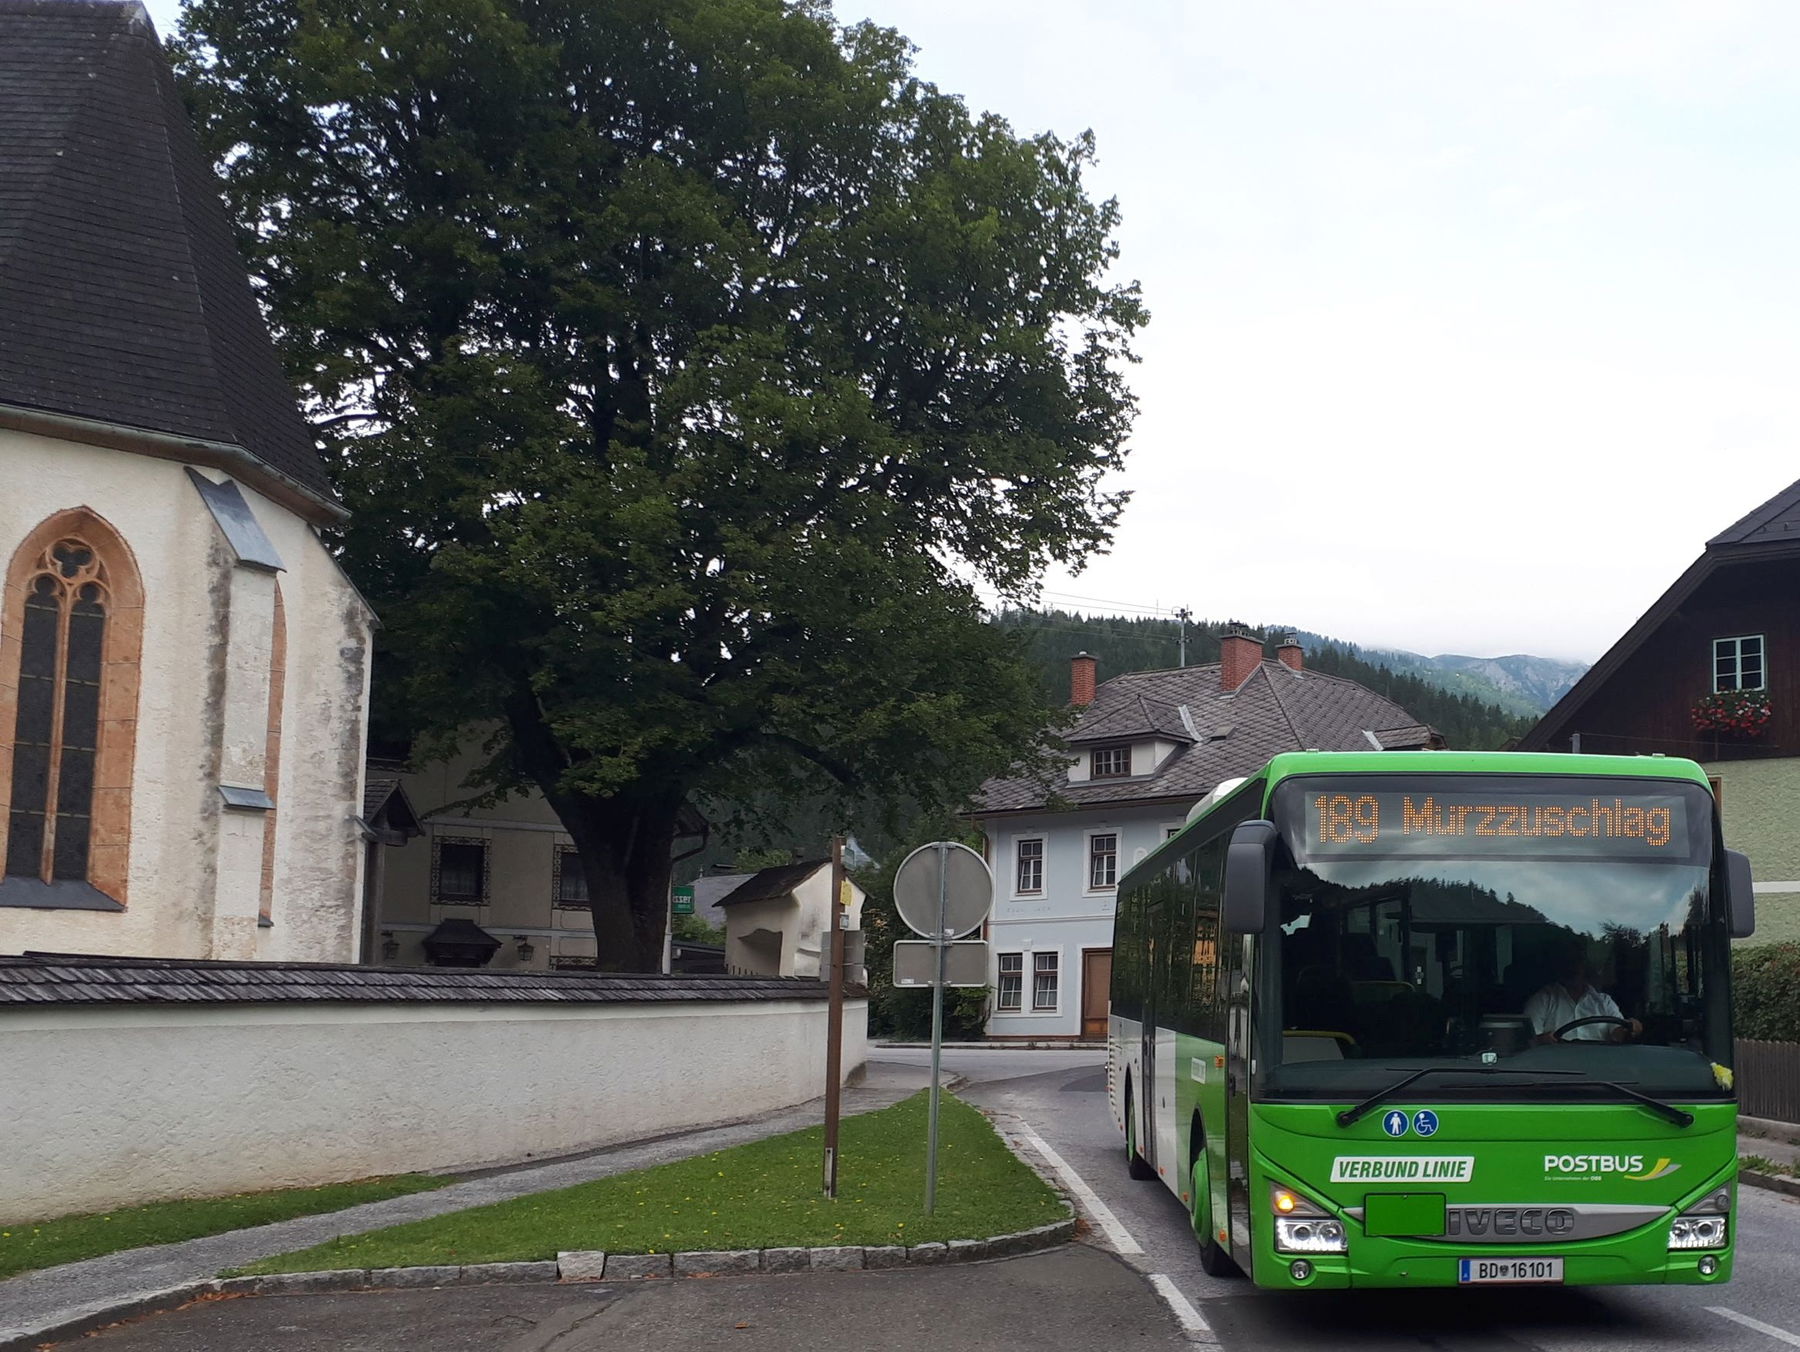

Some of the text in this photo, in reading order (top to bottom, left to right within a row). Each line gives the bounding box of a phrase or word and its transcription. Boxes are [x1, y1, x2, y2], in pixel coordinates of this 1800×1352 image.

[1314, 795, 1379, 844] 189
[1339, 1160, 1467, 1178] VERBUND LINIE
[1544, 1155, 1644, 1172] POSTBUS
[1448, 1207, 1575, 1236] IVECO
[1479, 1262, 1498, 1279] BD
[1510, 1261, 1553, 1279] 16101
